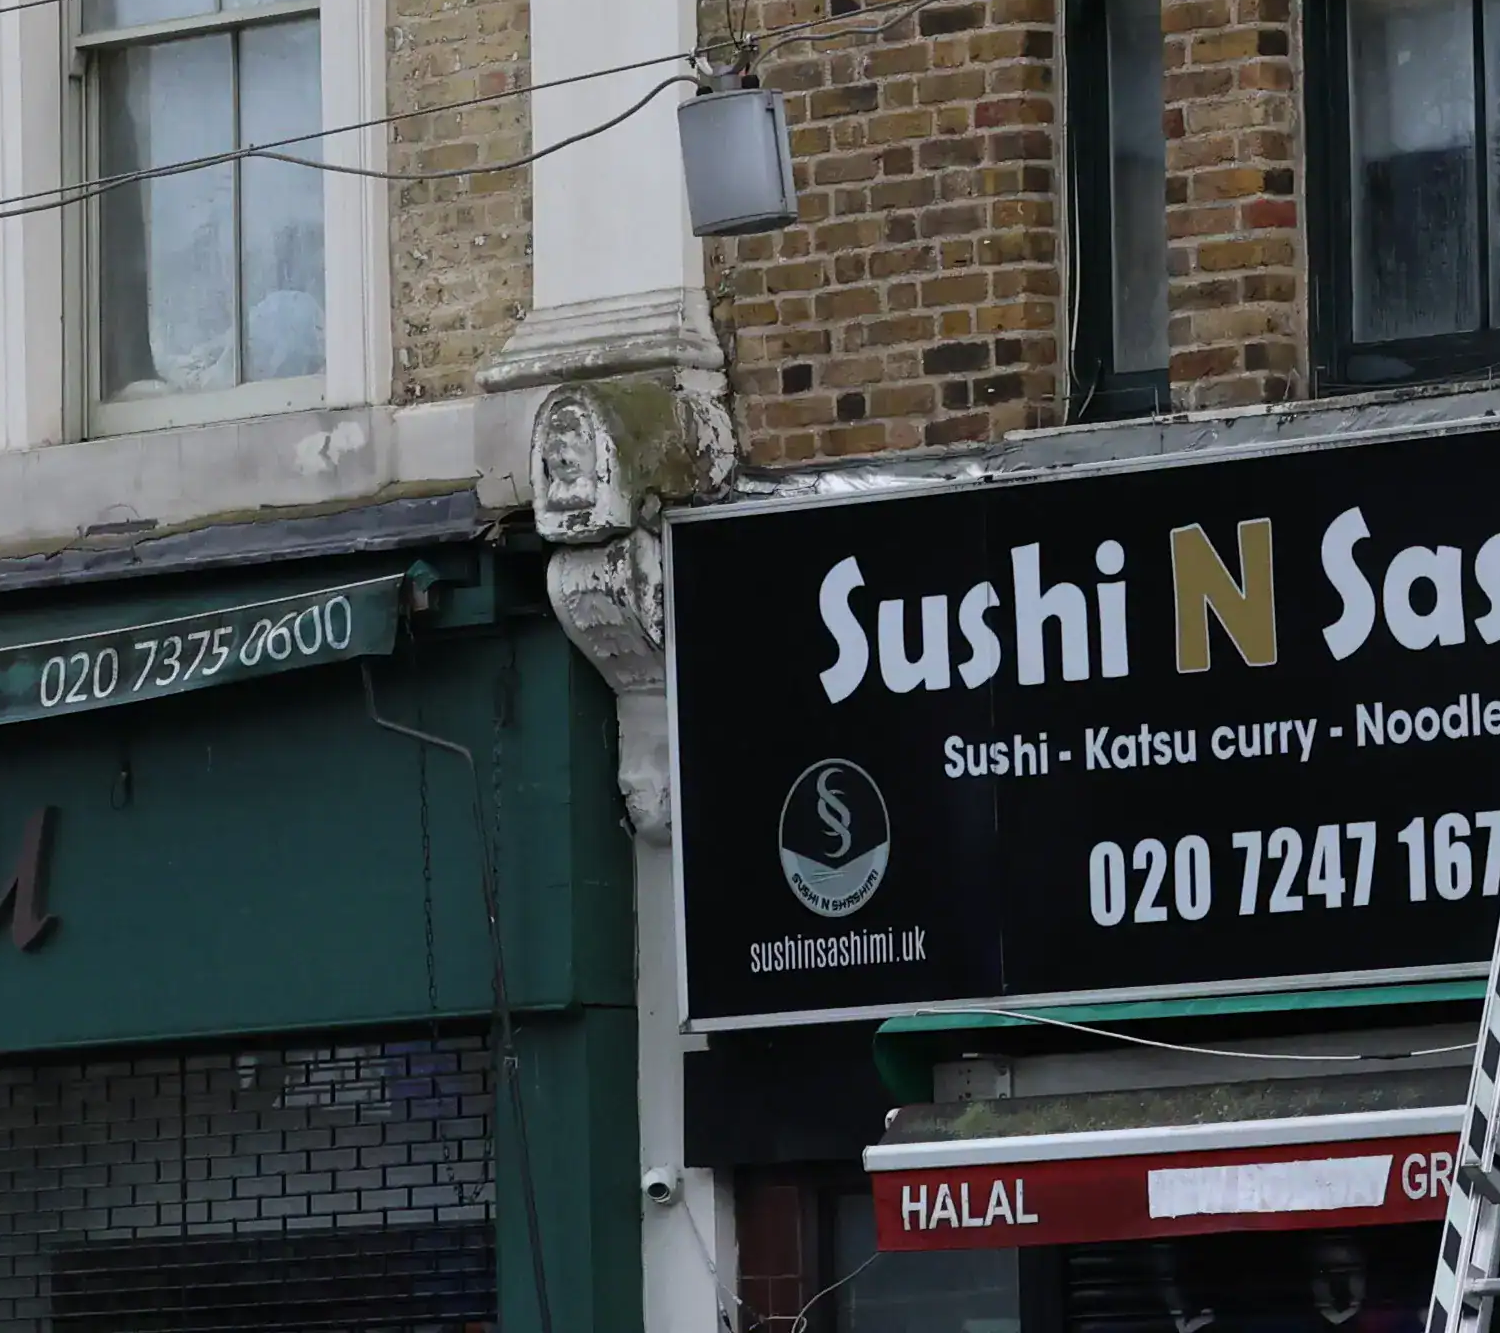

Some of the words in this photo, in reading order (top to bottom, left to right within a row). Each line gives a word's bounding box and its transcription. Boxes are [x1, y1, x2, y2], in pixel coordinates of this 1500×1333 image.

[819, 539, 1129, 705] Sushi
[1169, 517, 1278, 674] N
[40, 647, 119, 707] 020
[132, 626, 233, 692] 7375
[239, 595, 351, 666] 0600
[944, 733, 1049, 778] Sushi
[1085, 723, 1197, 770] Katsu
[1211, 718, 1318, 763] curry
[792, 872, 820, 906] SUSHI
[820, 897, 831, 911] N
[1089, 834, 1212, 926] 020
[1232, 820, 1377, 916] 7247
[750, 925, 927, 973] sushinsashimi.uk
[901, 1179, 1038, 1231] HALAL
